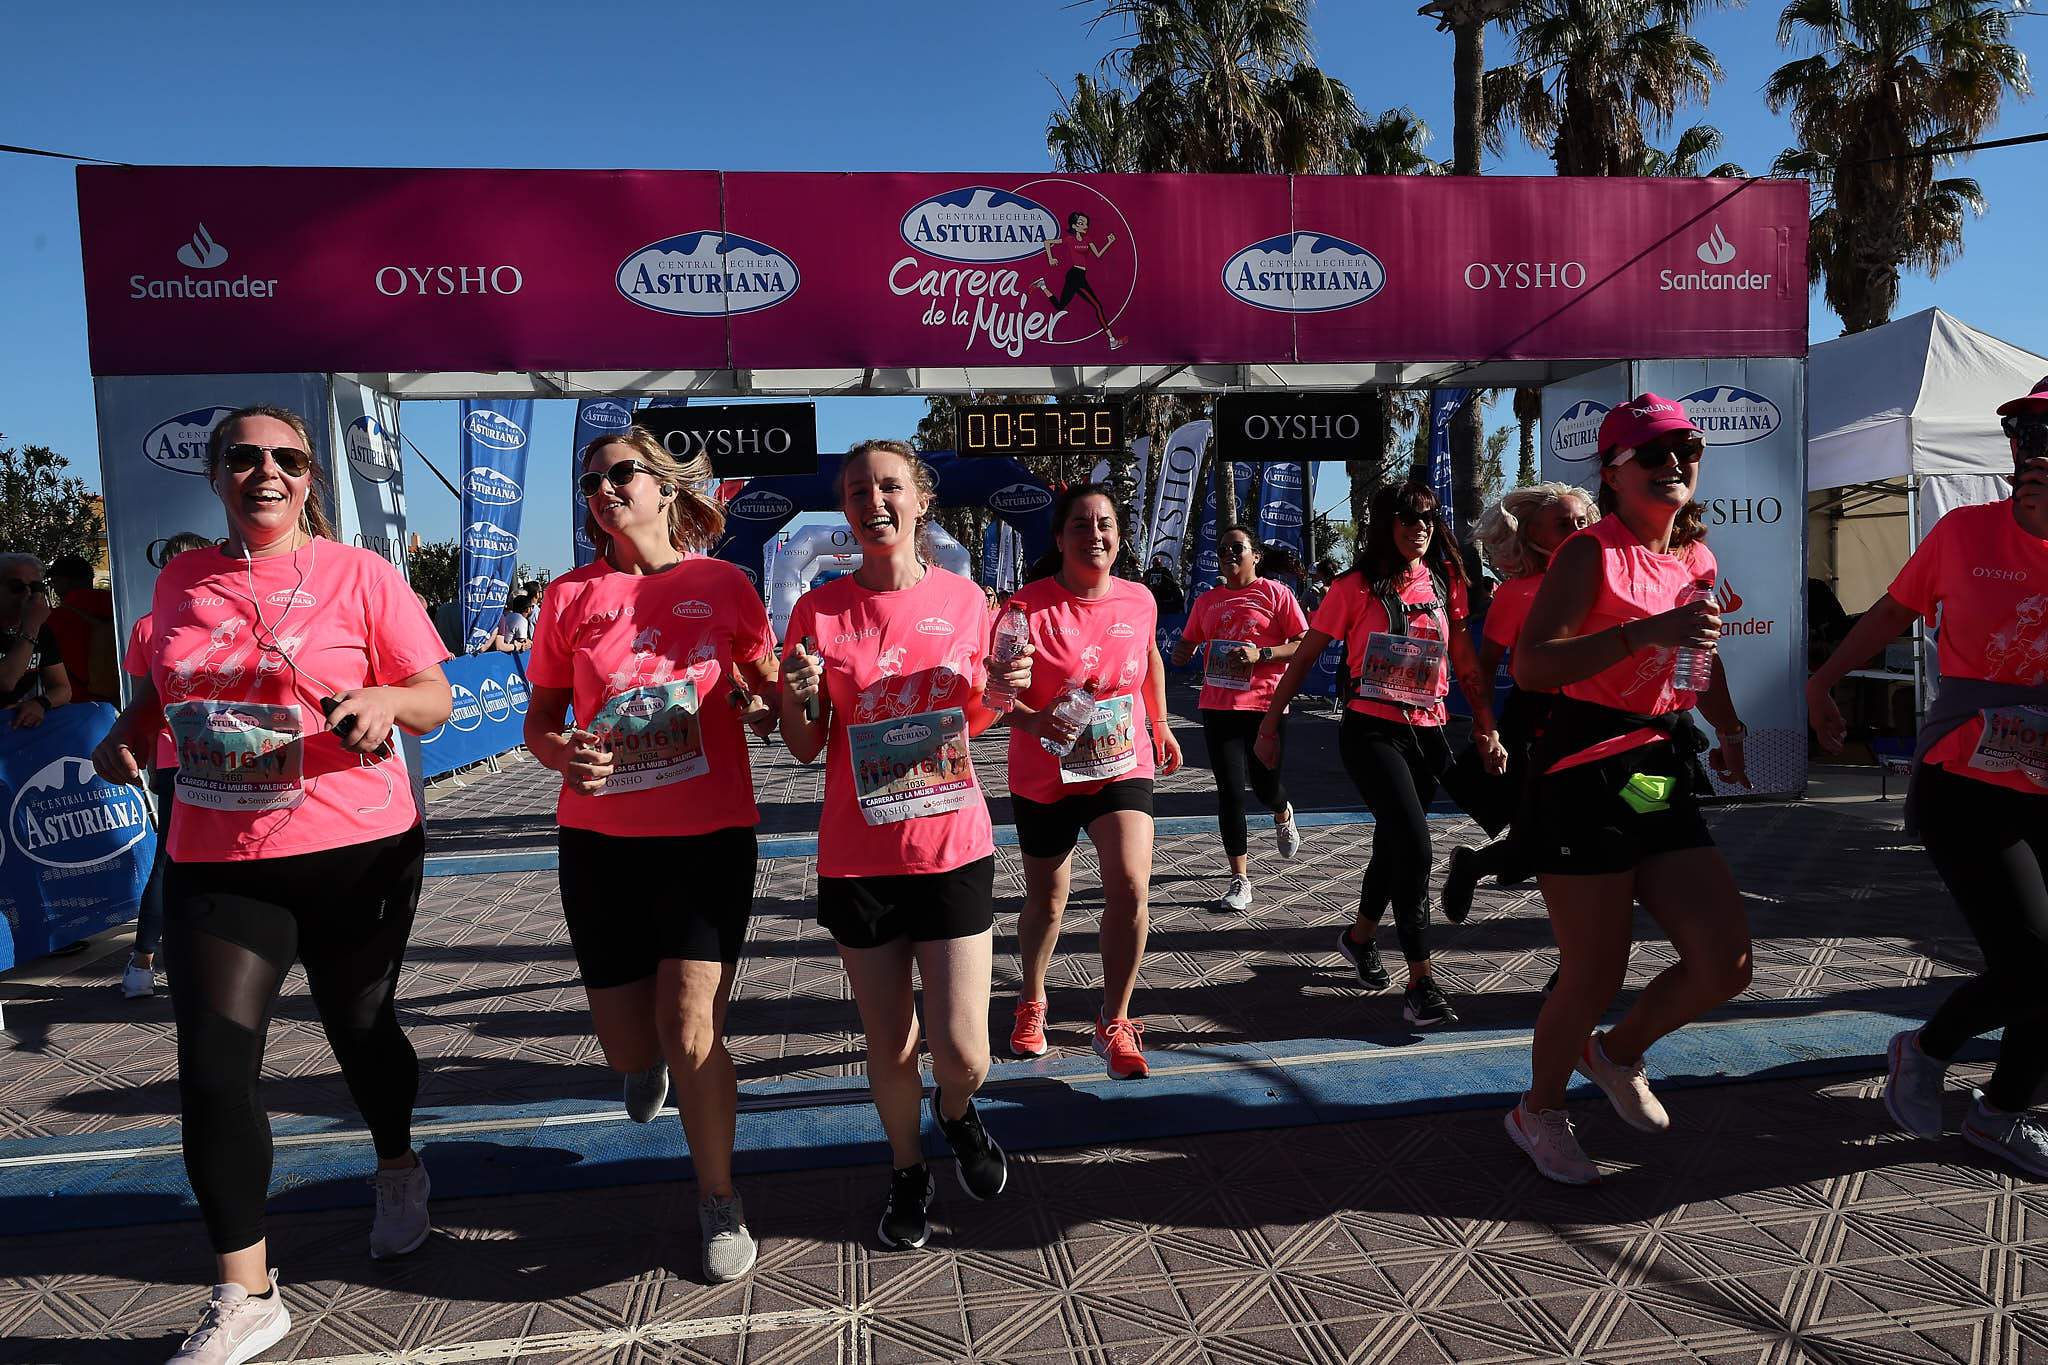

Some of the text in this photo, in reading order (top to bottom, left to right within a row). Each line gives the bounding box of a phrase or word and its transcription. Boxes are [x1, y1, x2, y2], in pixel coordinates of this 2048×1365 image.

[937, 212, 1044, 221] CENTRAL LECHERA
[914, 214, 1047, 243] ASTURIANA
[658, 260, 716, 270] CENTRAL
[1260, 259, 1368, 268] CENTRAL LECHERA
[375, 265, 524, 296] OYSHO
[631, 263, 786, 295] ASTURIANA
[888, 256, 1021, 297] Carrera
[1235, 262, 1374, 291] ASTURIANA
[1463, 261, 1587, 289] OYSHO
[1660, 269, 1772, 291] Santander
[129, 275, 278, 299] Santander
[922, 293, 1069, 358] de la Mujer
[585, 410, 627, 425] ASTURIANA
[1689, 415, 1772, 431] STURIANA
[470, 417, 520, 446] ASTURIANA
[968, 412, 1112, 447] 00:57:26
[1244, 414, 1360, 440] OYSHO
[663, 427, 792, 457] OYSHO
[733, 502, 788, 513] ASTURIANA
[994, 496, 1048, 507] ASTURIANA
[1700, 497, 1783, 525] SHO
[1973, 567, 2027, 581] OYSHO
[178, 597, 225, 611] OYSHO
[834, 626, 881, 644] OYSHO
[619, 701, 663, 714] ASTURIANA
[208, 720, 256, 728] ASTURIANA
[626, 730, 669, 752] 016
[886, 729, 929, 743] ASTURIANA
[211, 751, 257, 769] 016
[639, 752, 659, 761] 1034
[893, 758, 934, 778] 016
[181, 776, 209, 788] CARRERA
[227, 784, 253, 792] MUJER
[259, 783, 294, 791] VALENCIA
[606, 776, 642, 787] OYSHO
[905, 780, 926, 789] 1036
[40, 793, 85, 810] CENTRAL
[187, 791, 222, 802] OYSHO
[865, 795, 895, 806] CARRERA
[904, 791, 913, 799] LA
[914, 788, 935, 797] MUJER
[938, 781, 968, 792] VALENCIA
[874, 796, 966, 818] OYSHO Santander
[26, 800, 142, 850] ASTURIANA
